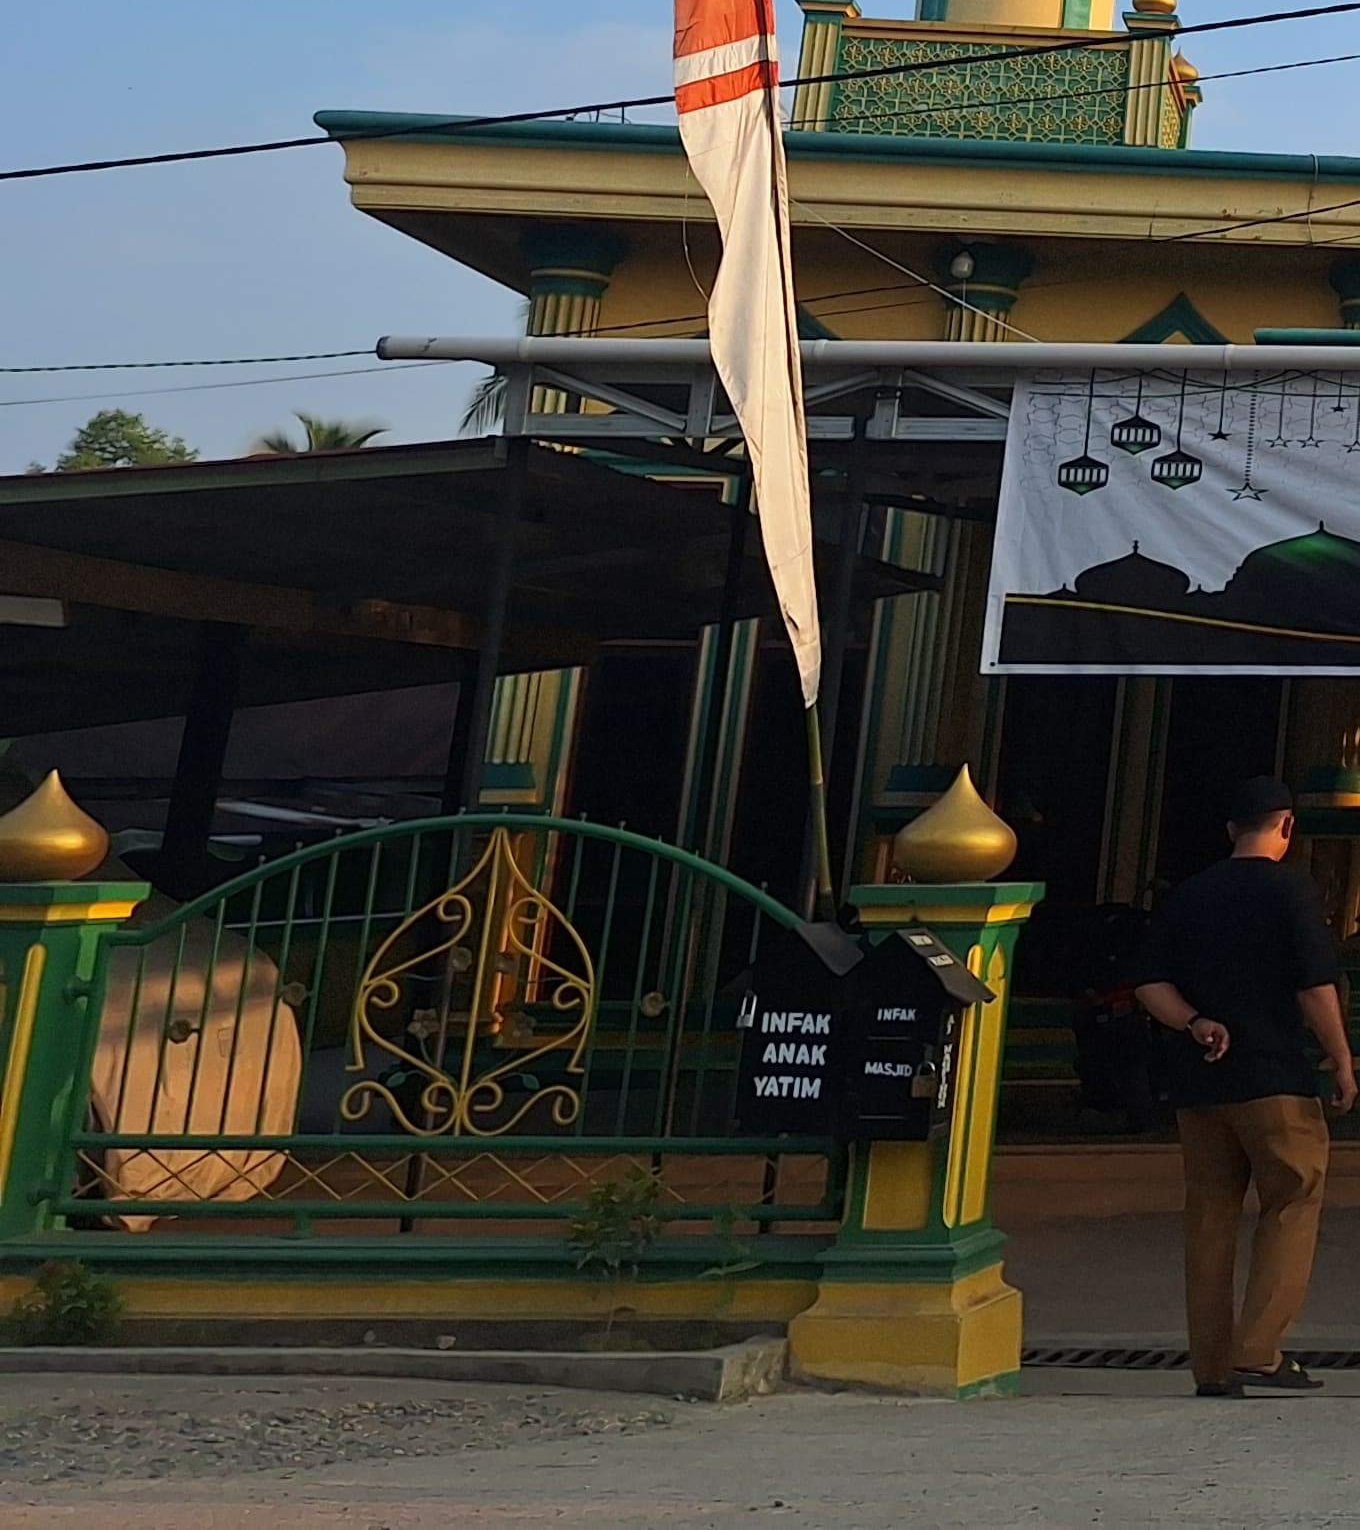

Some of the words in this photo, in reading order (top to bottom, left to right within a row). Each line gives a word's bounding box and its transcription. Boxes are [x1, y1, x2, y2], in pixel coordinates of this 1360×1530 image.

[761, 1011, 831, 1035] INFAK
[877, 1007, 916, 1021] INFAK
[762, 1042, 828, 1066] ANAK
[864, 1061, 913, 1077] MASJID
[753, 1075, 822, 1099] YATIM
